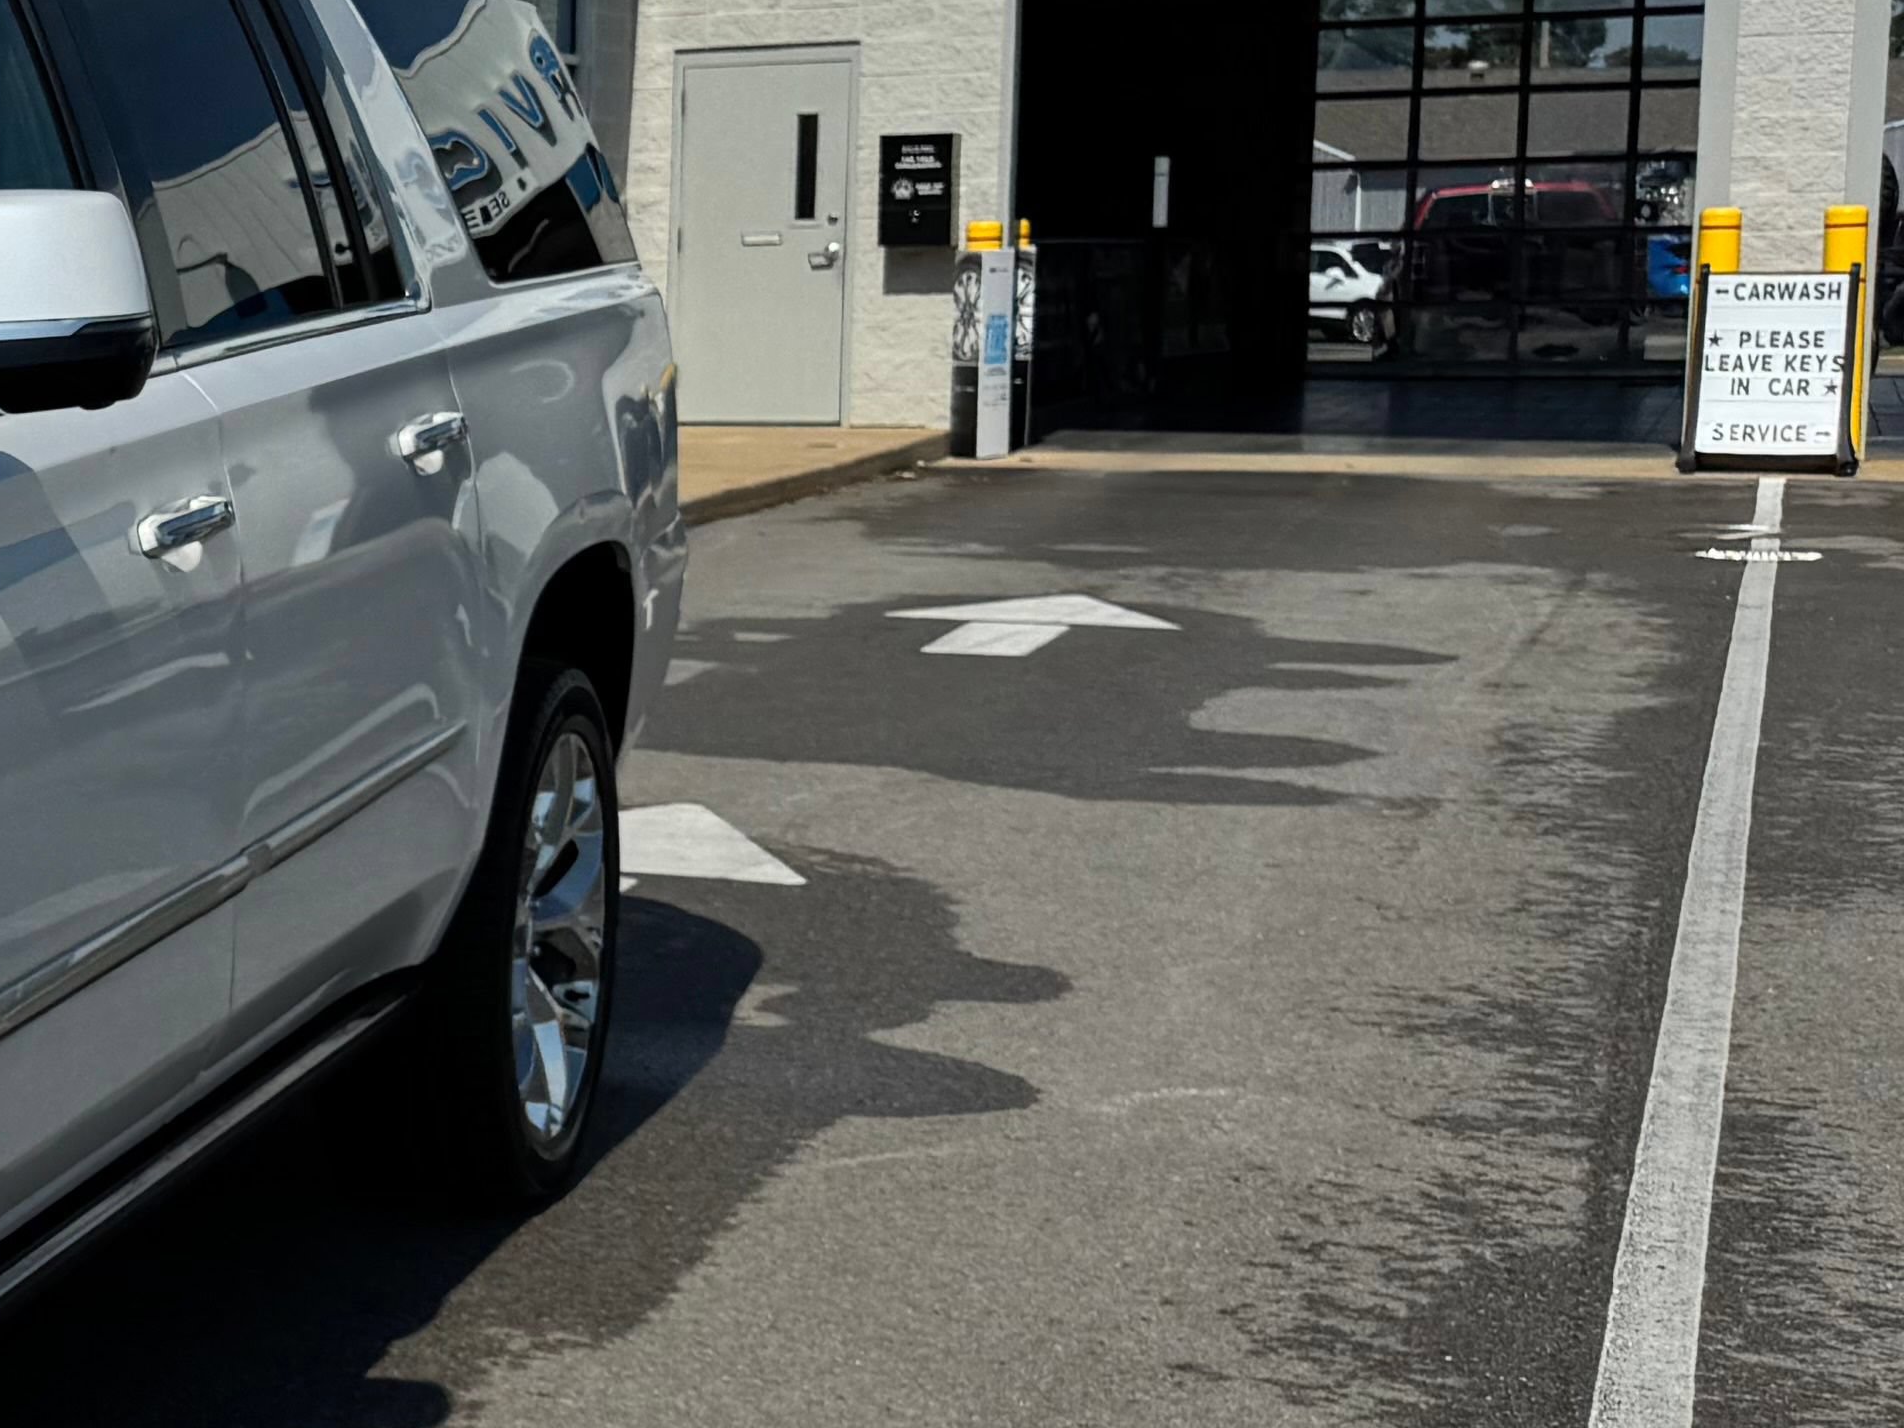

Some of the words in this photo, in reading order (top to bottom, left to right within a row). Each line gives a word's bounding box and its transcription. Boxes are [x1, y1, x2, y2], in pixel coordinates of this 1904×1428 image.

[1734, 281, 1842, 302] CARWASH
[1739, 330, 1826, 349] PLEASE
[1704, 354, 1773, 373] LEAVE
[1785, 354, 1846, 373] KEYS
[1730, 377, 1750, 396] IN
[1768, 377, 1810, 396] CAR
[1712, 423, 1808, 442] SERVICE
